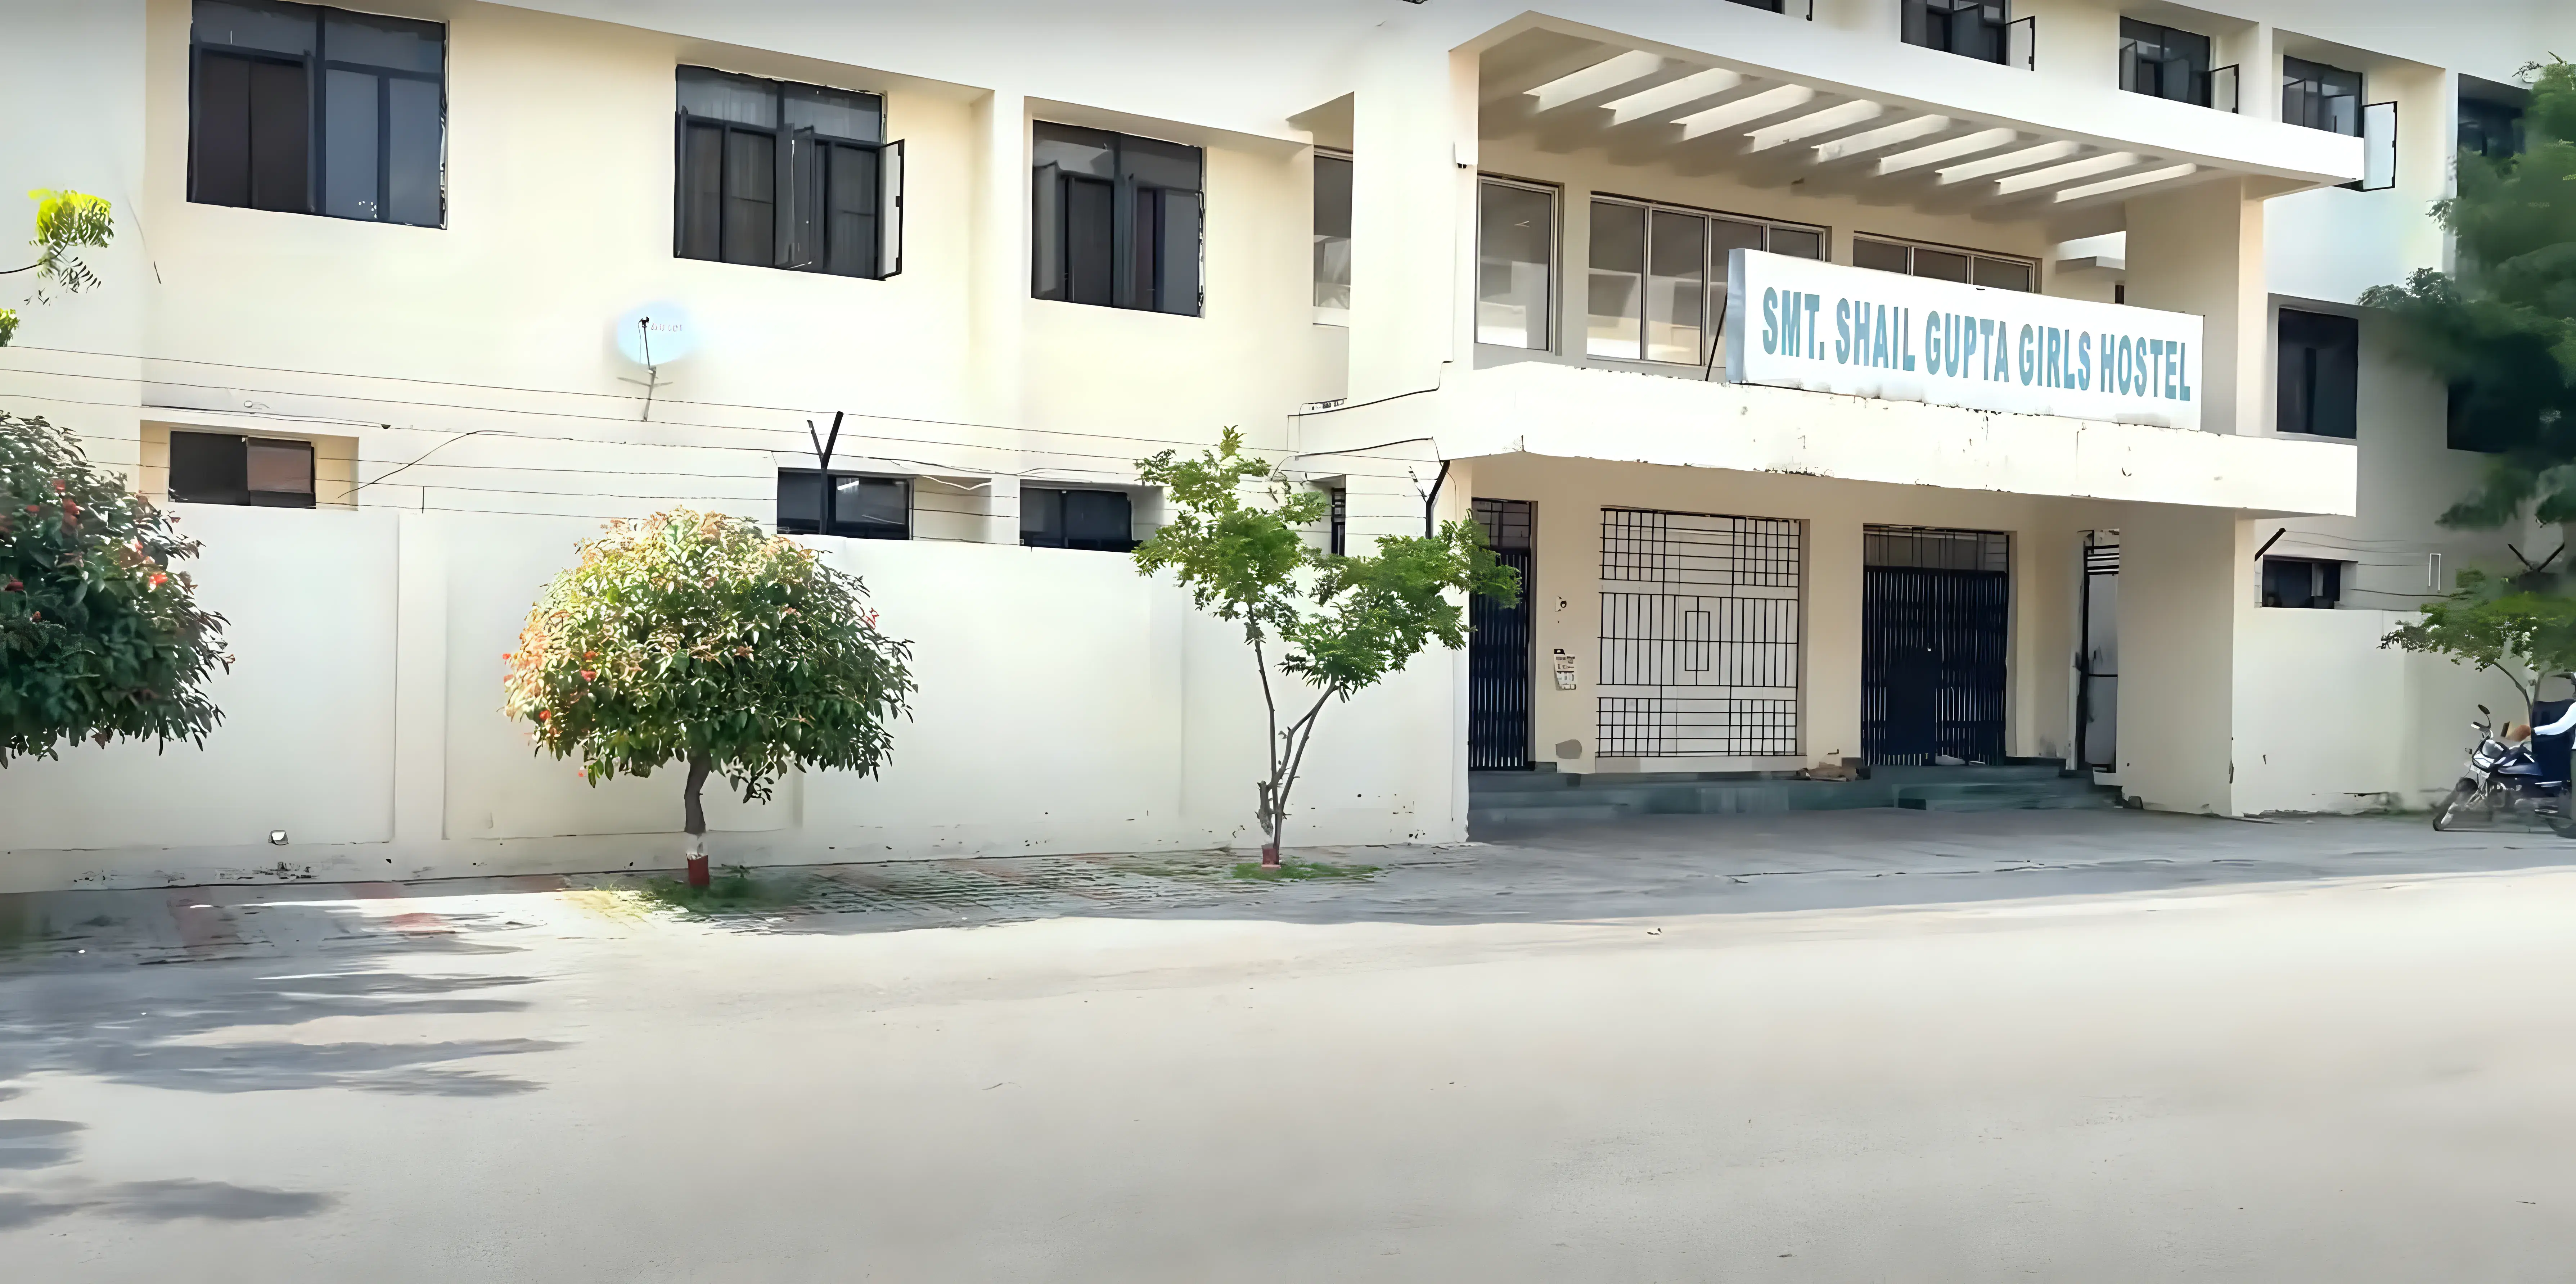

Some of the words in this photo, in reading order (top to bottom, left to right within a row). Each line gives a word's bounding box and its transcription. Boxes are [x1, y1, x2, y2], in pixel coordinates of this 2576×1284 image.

[1762, 286, 1825, 361] SMT.
[1835, 298, 1915, 372] SHAIL
[1925, 310, 2009, 383] GUPTA
[2019, 324, 2091, 391] GIRLS
[2100, 333, 2190, 402] HOSTEL
